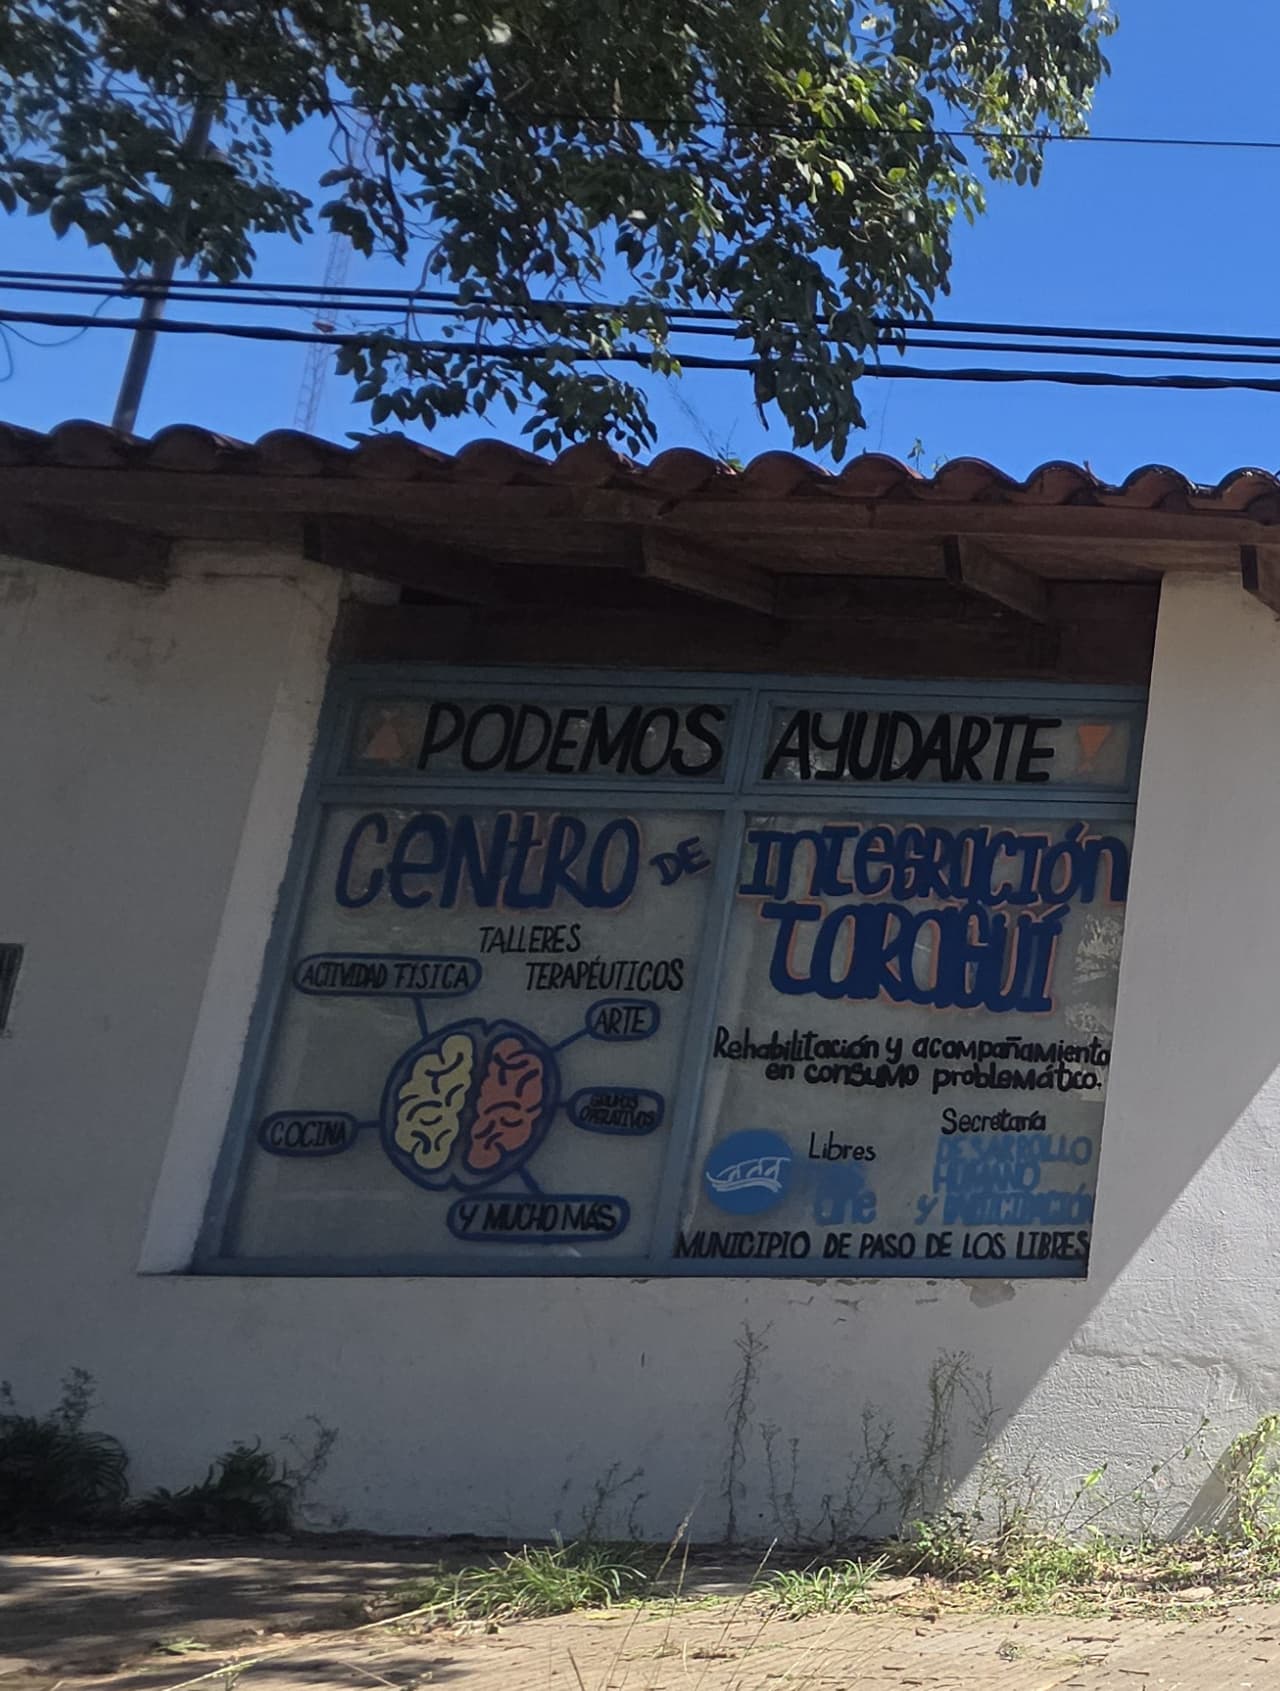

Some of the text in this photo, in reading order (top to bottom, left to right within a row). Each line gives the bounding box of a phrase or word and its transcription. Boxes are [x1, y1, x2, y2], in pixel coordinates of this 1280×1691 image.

[417, 702, 1062, 783] PODEMOS AYUDARTE
[649, 835, 711, 886] DE
[479, 923, 582, 954] TALLERES
[301, 960, 388, 989] ACTIVIDAD
[525, 956, 684, 991] TERAPÉUTICOS
[592, 1006, 646, 1034] ARTE
[713, 1026, 880, 1062] Rehabilitación
[886, 1036, 903, 1064] y
[765, 1062, 795, 1080] en
[271, 1119, 347, 1148] COCINA
[942, 1108, 1047, 1135] Secretaría
[808, 1130, 877, 1162] Libres
[483, 1202, 559, 1233] MUCHO
[673, 1230, 1090, 1261] MUNICIPIO DE PASO DE LOS LIBRES
